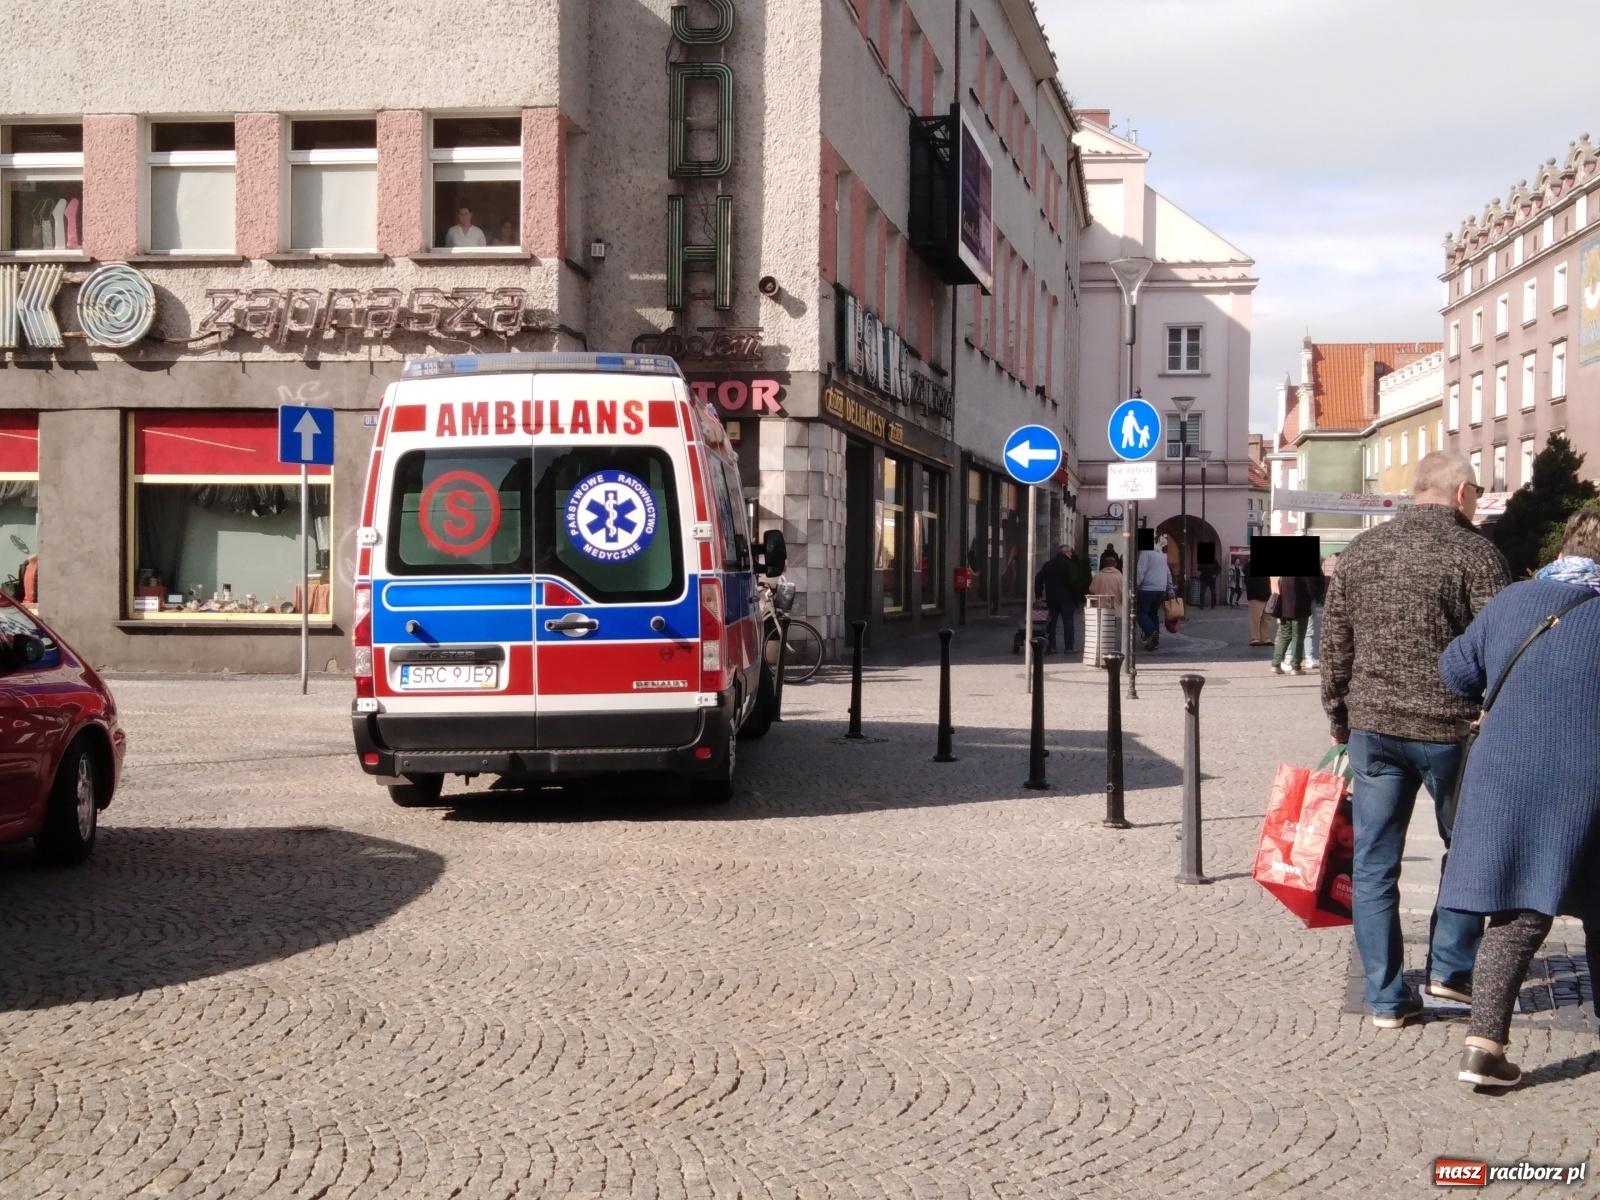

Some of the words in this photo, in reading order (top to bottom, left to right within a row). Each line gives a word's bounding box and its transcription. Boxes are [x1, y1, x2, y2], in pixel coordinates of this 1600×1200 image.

[200, 286, 527, 346] zaprasza
[435, 400, 644, 437] AMBULANS
[845, 396, 887, 440] DELIKATESY
[442, 489, 477, 538] S
[566, 474, 605, 536] PAŃSTWOWE
[617, 473, 656, 535] RATOWNICTWO
[583, 542, 642, 560] MEDYCZNE
[418, 650, 476, 659] MASTER
[412, 666, 447, 683] SRC
[453, 666, 494, 683] 9JE9
[633, 680, 688, 689] RENAULT
